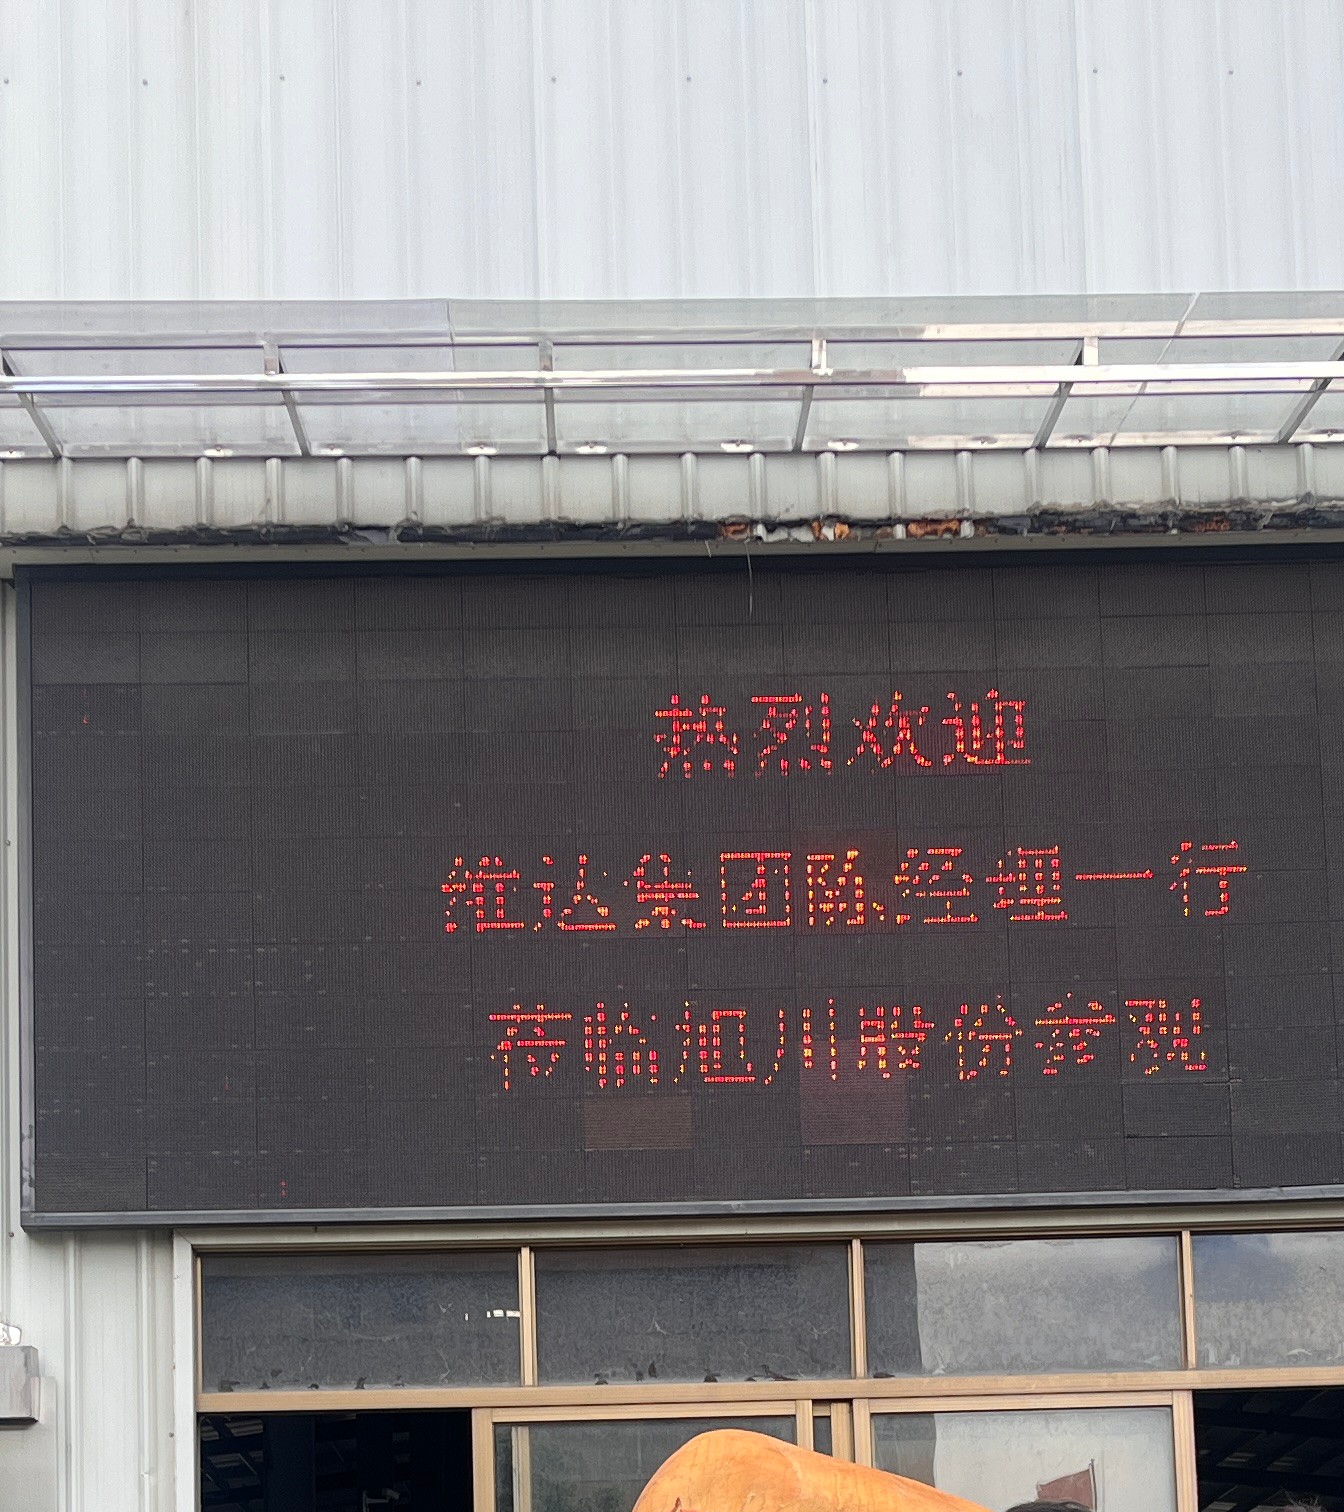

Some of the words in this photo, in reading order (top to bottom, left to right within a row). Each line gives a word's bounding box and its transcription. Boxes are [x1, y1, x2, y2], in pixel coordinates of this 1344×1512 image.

[654, 687, 1032, 780] 热烈欢迎
[440, 841, 1248, 934] 维达集团陈经理一行
[486, 994, 1209, 1090] 莅临旭川股份参观
